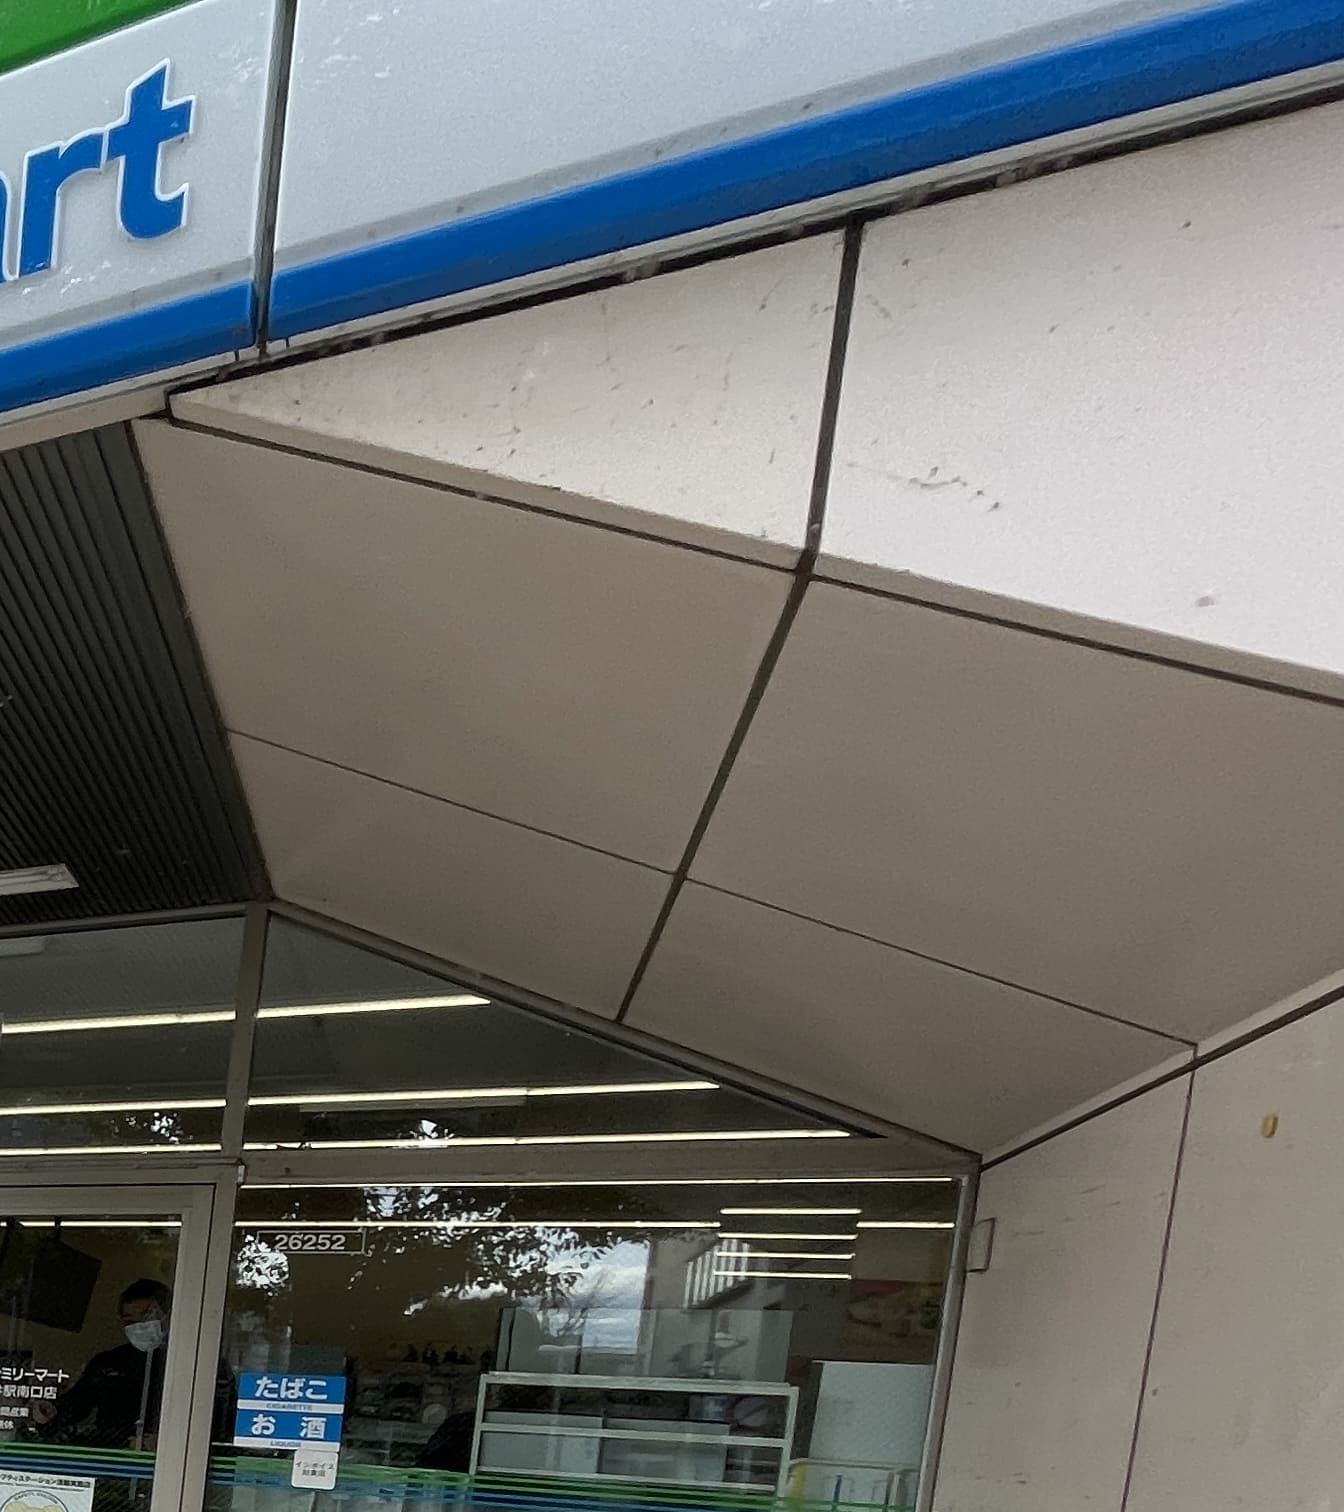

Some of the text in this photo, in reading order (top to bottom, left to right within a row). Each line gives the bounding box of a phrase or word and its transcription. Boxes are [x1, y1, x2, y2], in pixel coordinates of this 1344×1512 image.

[274, 1234, 346, 1250] 26252
[254, 1376, 328, 1400] たばこ
